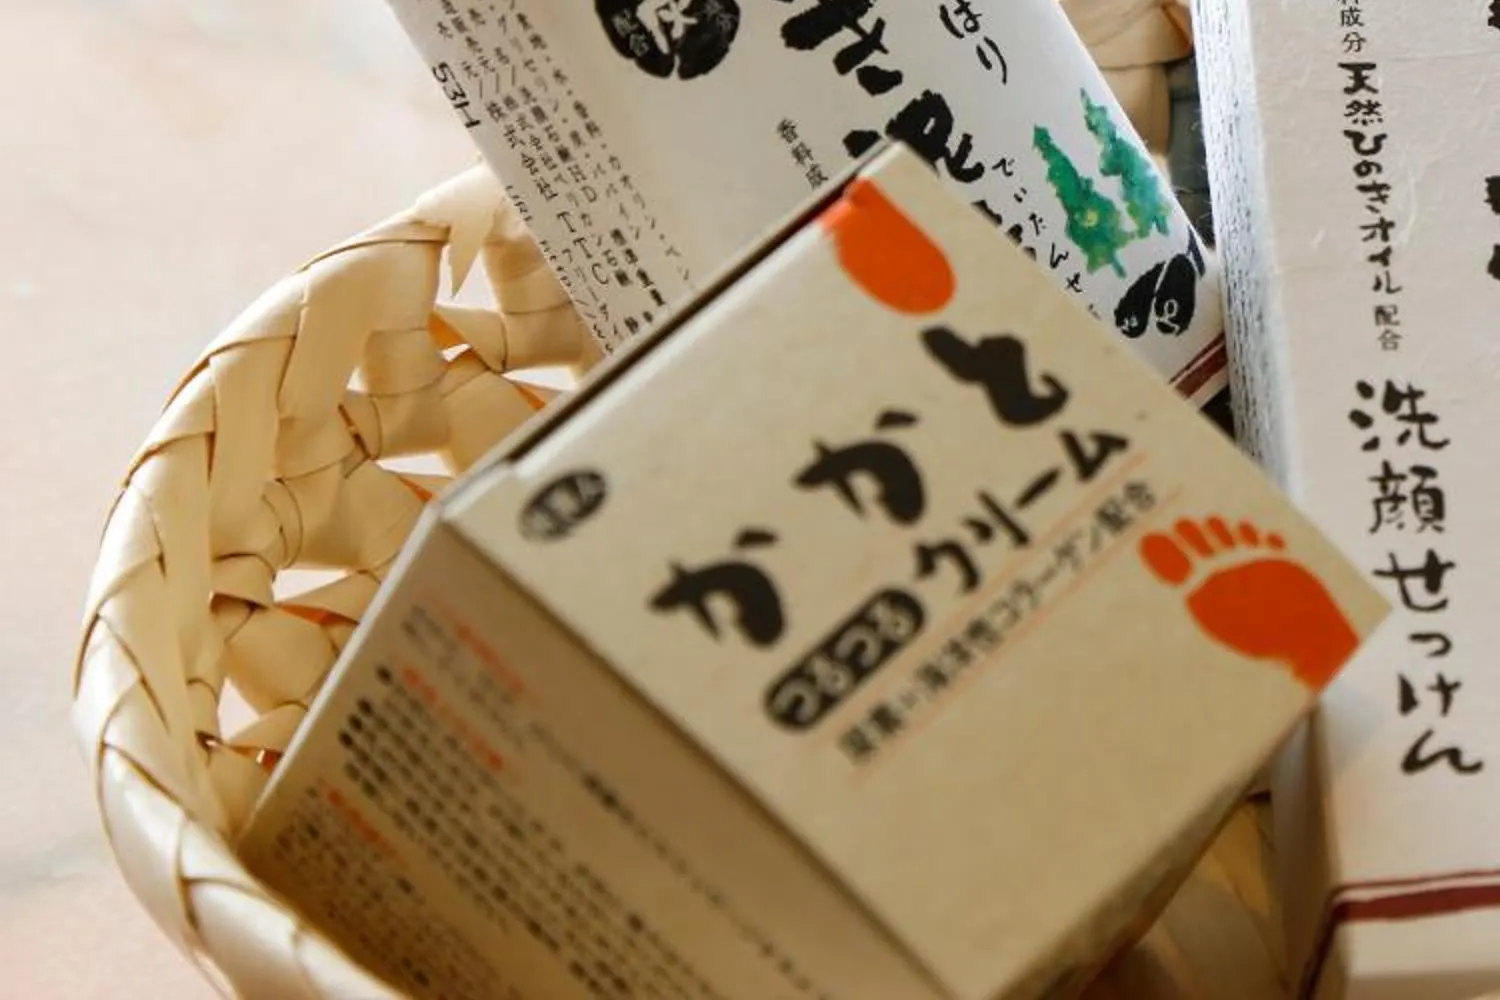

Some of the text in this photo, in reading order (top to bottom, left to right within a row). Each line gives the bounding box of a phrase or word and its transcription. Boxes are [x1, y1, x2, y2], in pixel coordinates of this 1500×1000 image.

[646, 325, 1071, 652] かかと
[772, 427, 1130, 726] つるつる クリーム
[1349, 379, 1485, 777] 洗顔せっけん
